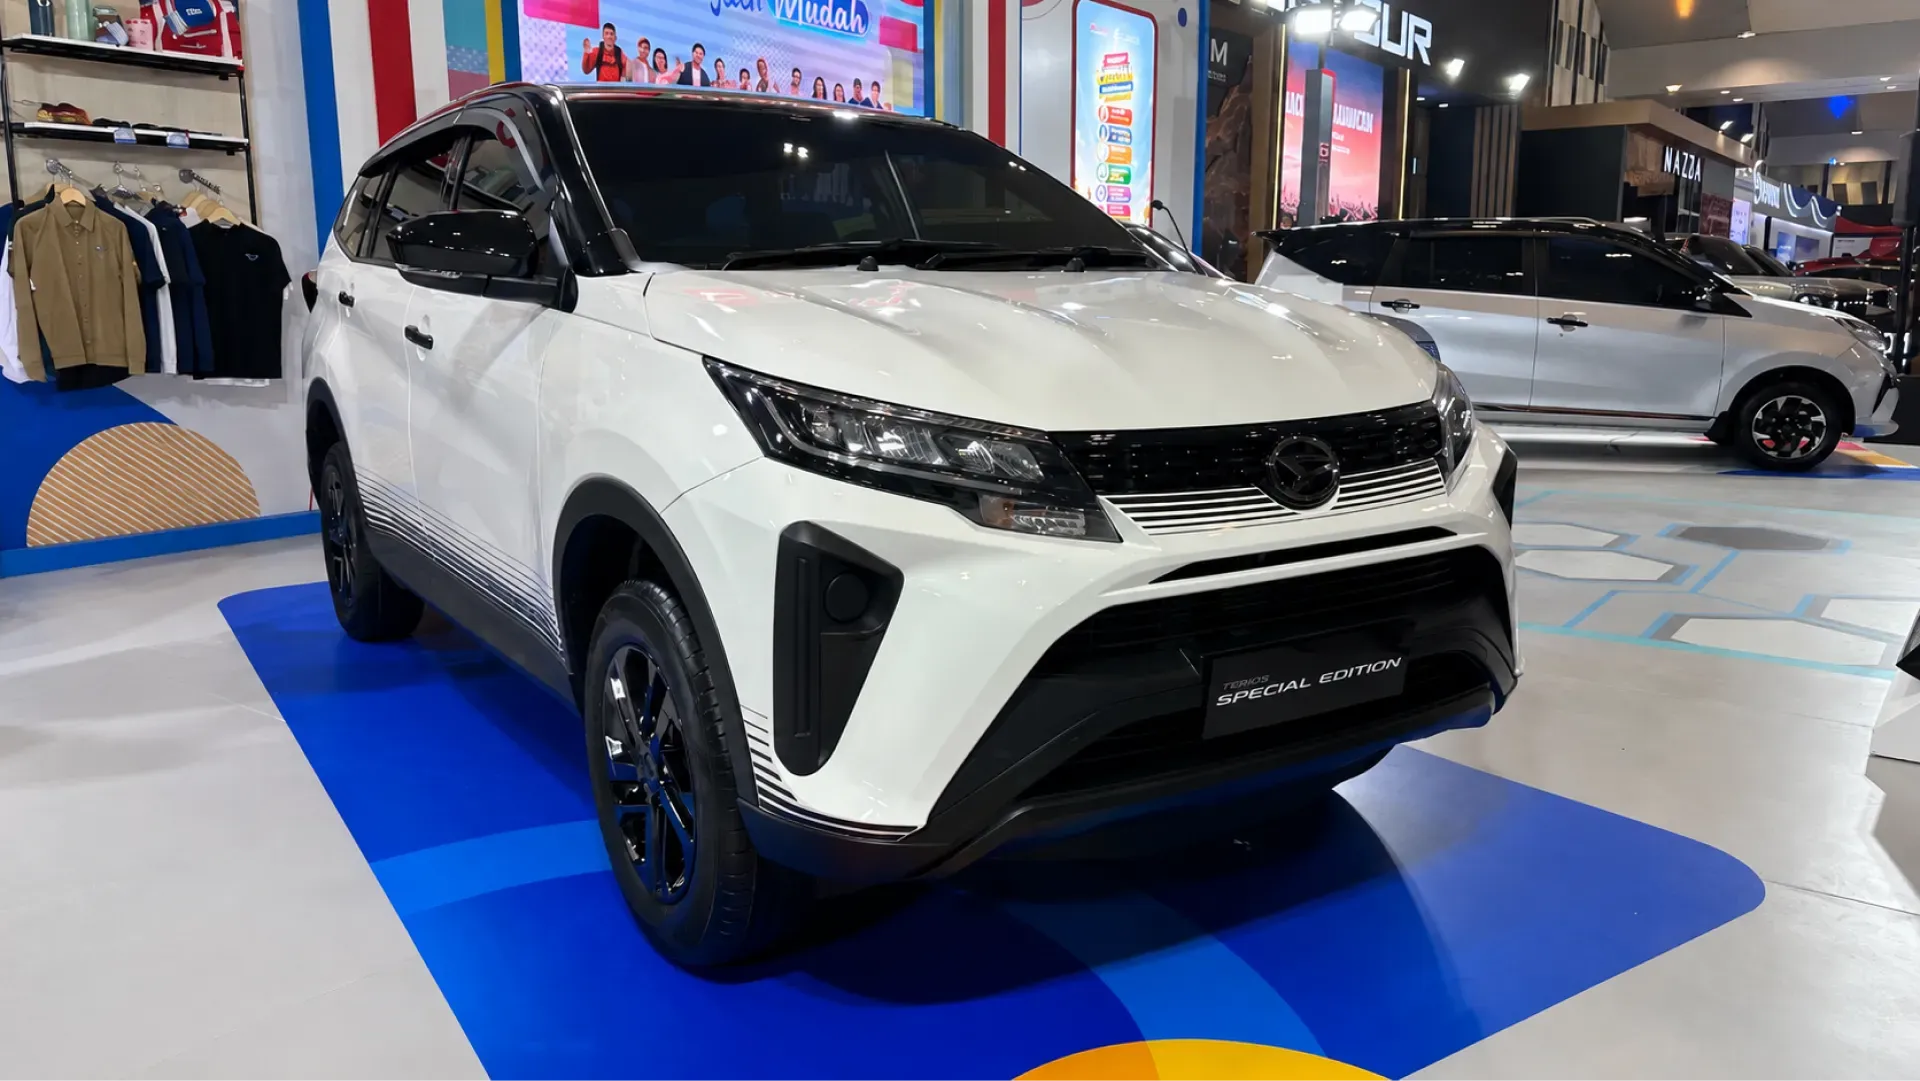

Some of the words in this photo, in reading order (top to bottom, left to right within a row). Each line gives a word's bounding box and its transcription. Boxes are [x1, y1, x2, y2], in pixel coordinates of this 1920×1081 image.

[774, 0, 866, 34] Mudah
[1216, 677, 1311, 706] SPECIAL
[1318, 656, 1402, 684] EDITION
[1222, 674, 1270, 690] TERIOS
